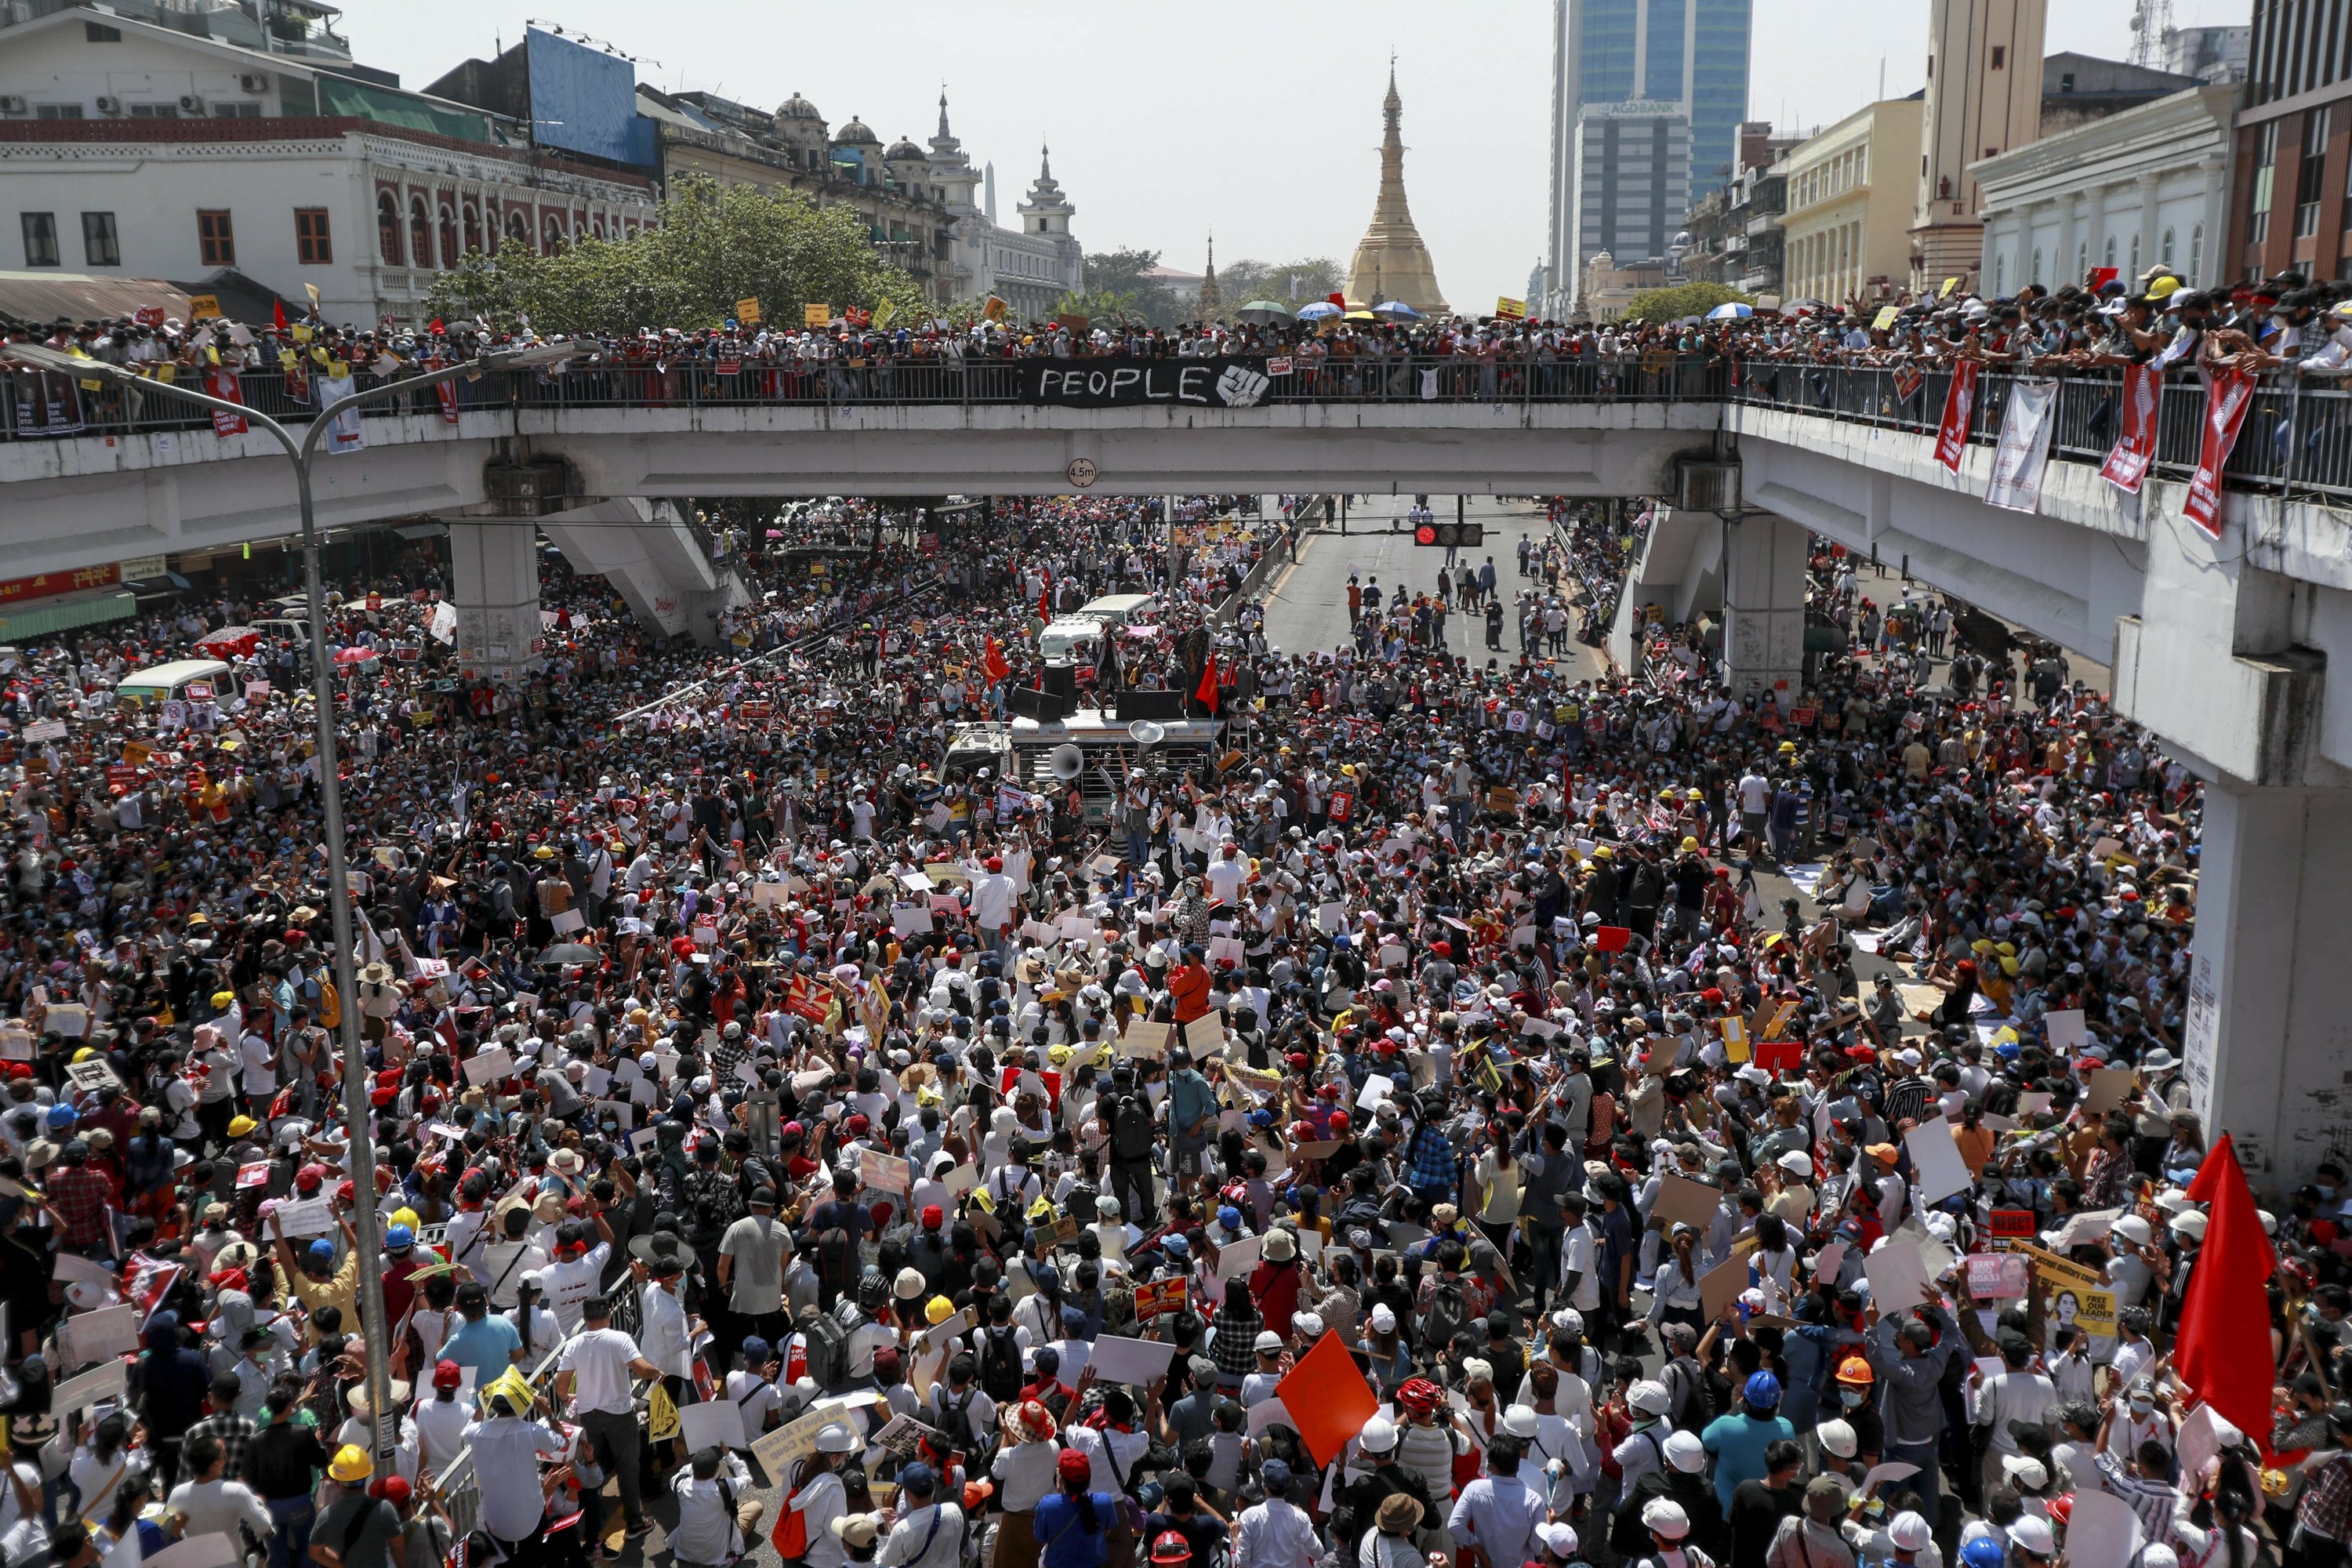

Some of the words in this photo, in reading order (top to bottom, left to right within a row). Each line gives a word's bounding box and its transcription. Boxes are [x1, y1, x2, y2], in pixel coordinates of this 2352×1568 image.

[1610, 102, 1638, 114] AGD
[1639, 101, 1675, 114] BANK
[1271, 365, 1290, 373] CDM
[1040, 366, 1210, 402] PEOPLE
[1070, 467, 1094, 477] 4.5m
[2198, 467, 2213, 485] HEAR
[2194, 481, 2205, 496] THE
[1655, 809, 1672, 826] CDM
[777, 853, 790, 862] CDM
[1229, 1069, 1243, 1078] FOR
[1994, 1216, 2031, 1231] REJECT
[2009, 1242, 2018, 1252] We
[2036, 1254, 2056, 1269] accept
[2057, 1261, 2082, 1278] military
[2082, 1270, 2096, 1284] coup
[2081, 1308, 2114, 1318] LEADER
[553, 1515, 579, 1530] LEADER
